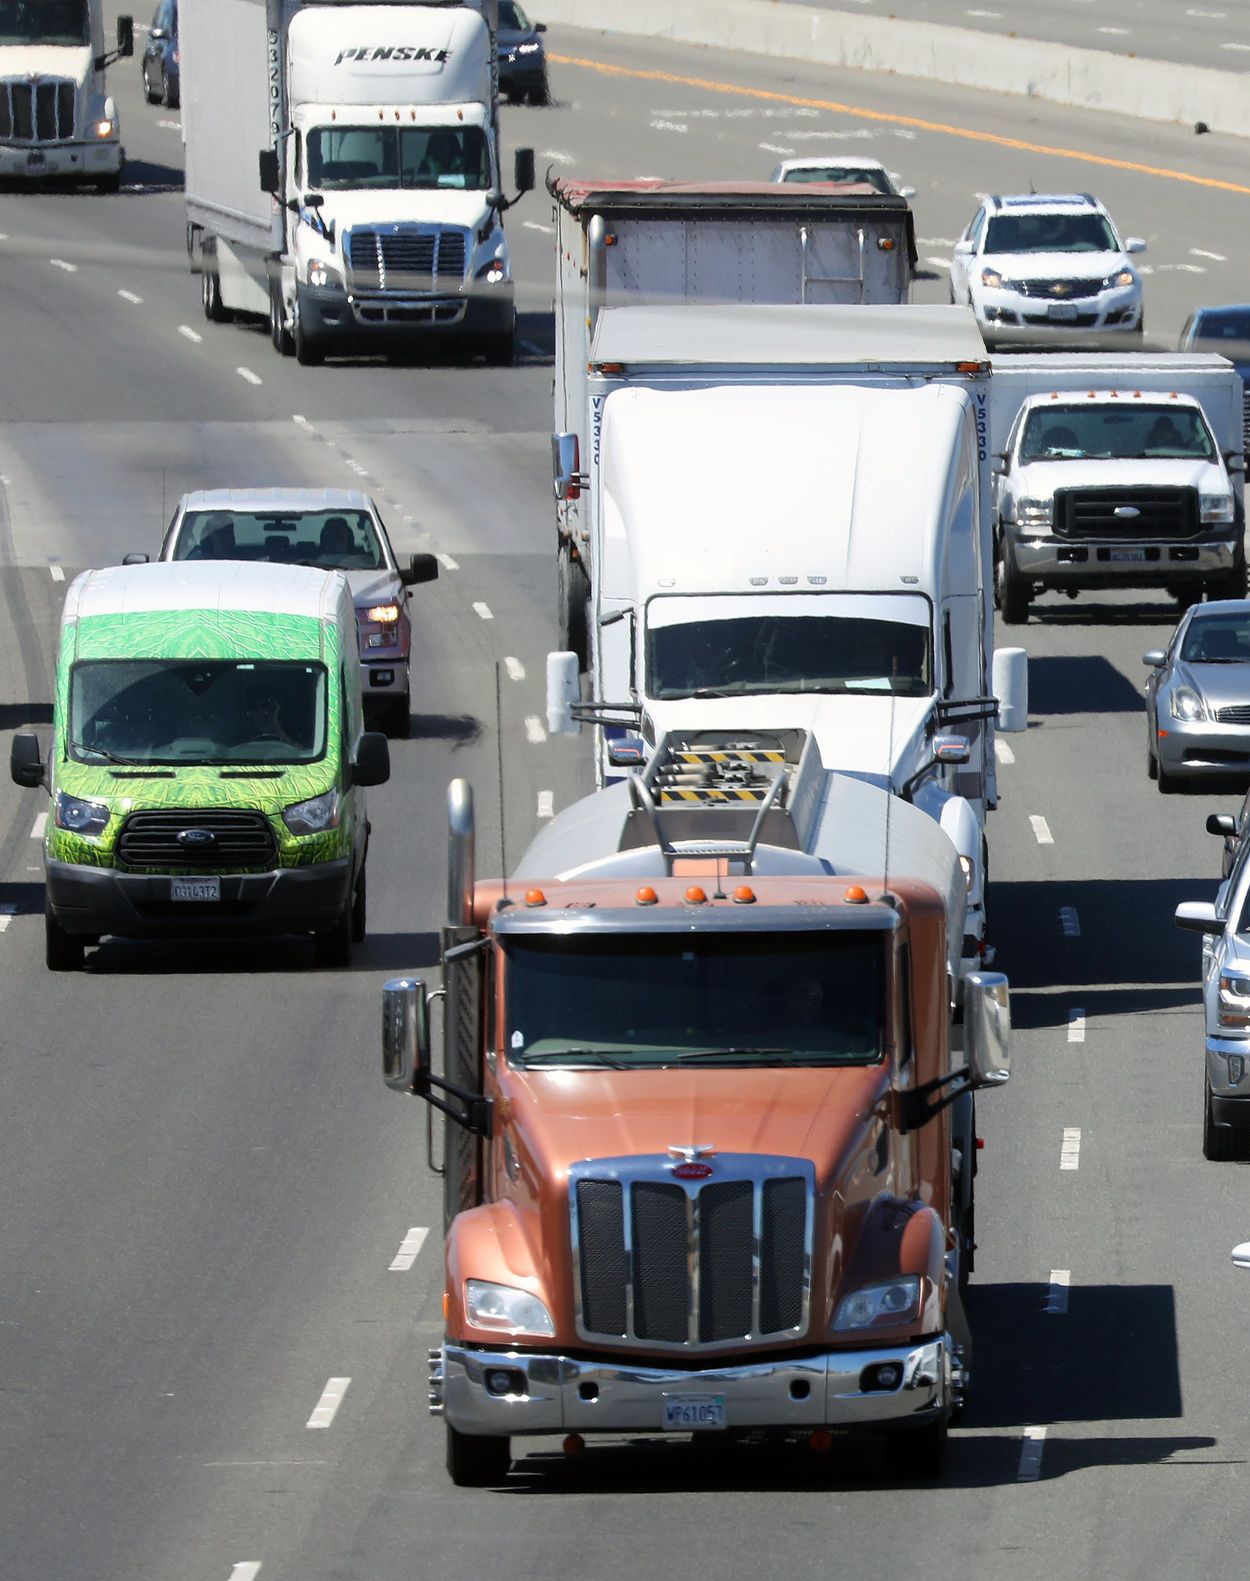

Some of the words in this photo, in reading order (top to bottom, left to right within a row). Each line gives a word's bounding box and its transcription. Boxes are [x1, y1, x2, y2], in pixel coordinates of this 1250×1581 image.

[334, 47, 449, 65] PENSKE
[976, 393, 987, 461] V5330
[666, 1405, 723, 1422] WP61057
